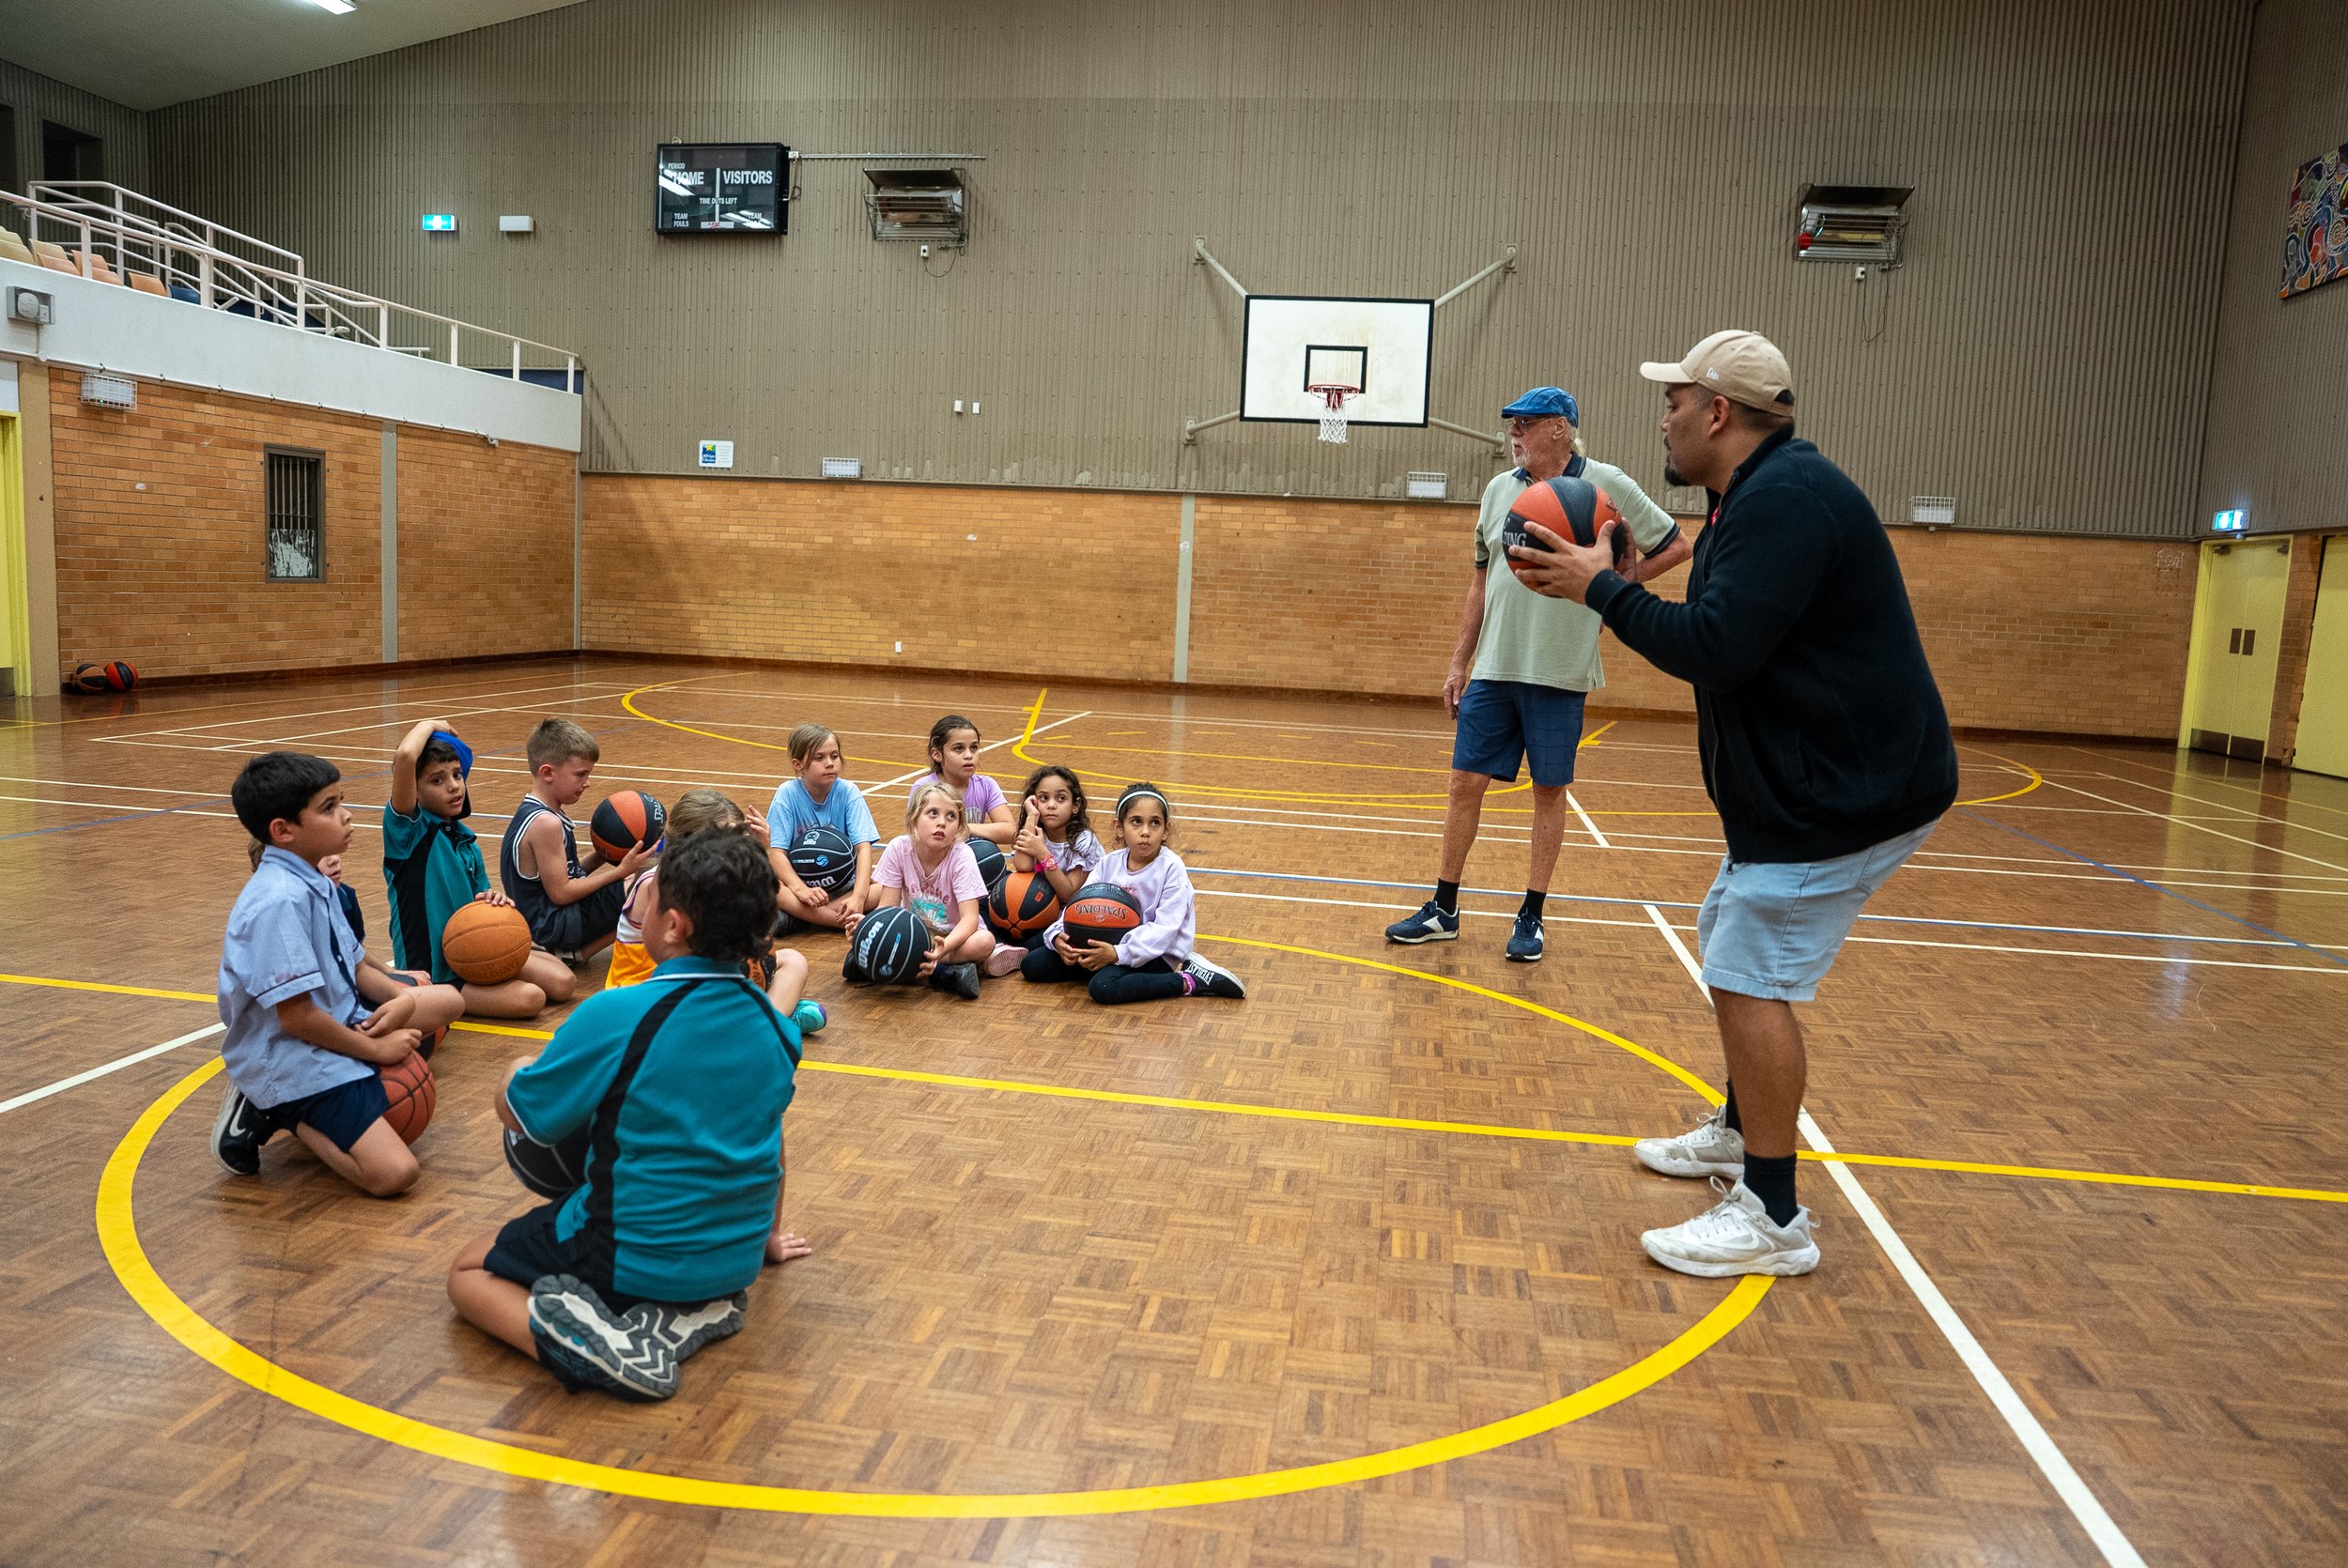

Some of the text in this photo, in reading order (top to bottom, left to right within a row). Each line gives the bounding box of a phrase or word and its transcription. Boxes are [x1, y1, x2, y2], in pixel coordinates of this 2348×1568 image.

[673, 171, 704, 185] HOME
[723, 170, 773, 185] VISITORS
[1502, 531, 1527, 547] DING
[1074, 903, 1127, 920] SPALDING
[857, 921, 885, 970] Wilson
[1184, 961, 1215, 986] EVERLAST
